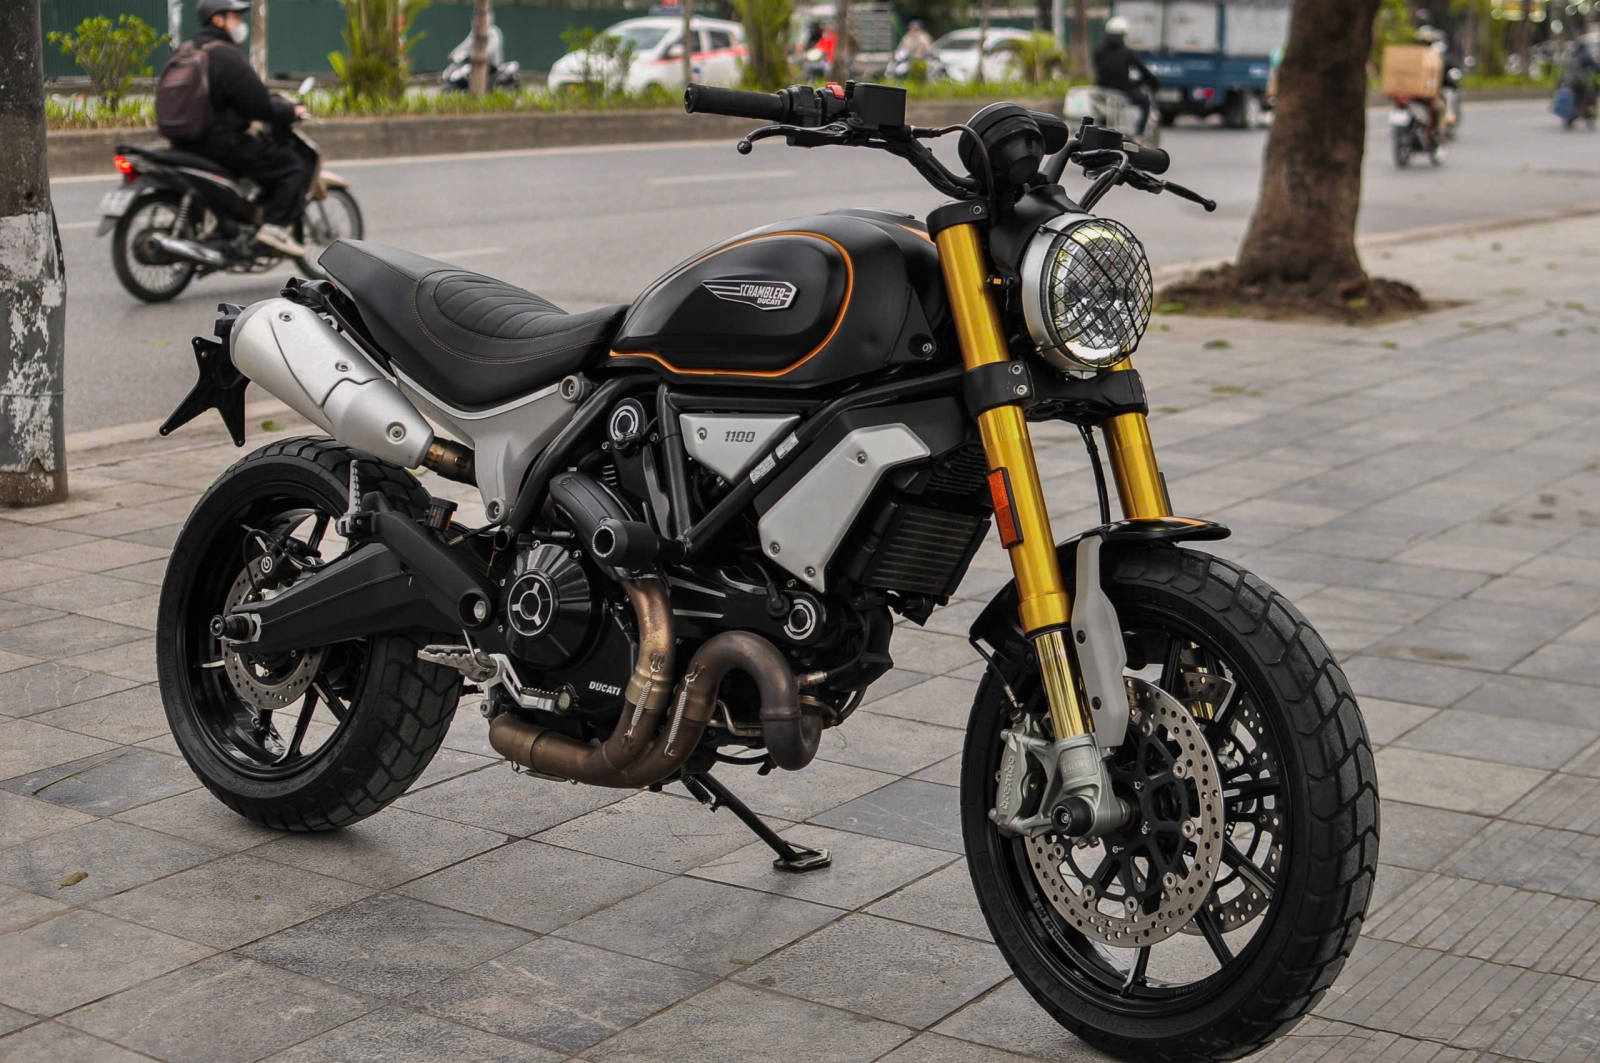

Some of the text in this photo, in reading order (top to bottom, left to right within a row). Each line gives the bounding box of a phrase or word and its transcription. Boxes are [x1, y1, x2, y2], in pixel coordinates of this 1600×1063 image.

[740, 284, 786, 299] SCRAMBLER
[757, 298, 781, 306] DUCATI
[724, 430, 756, 443] 1100
[589, 681, 621, 696] DUCATI
[1000, 755, 1016, 810] brembo
